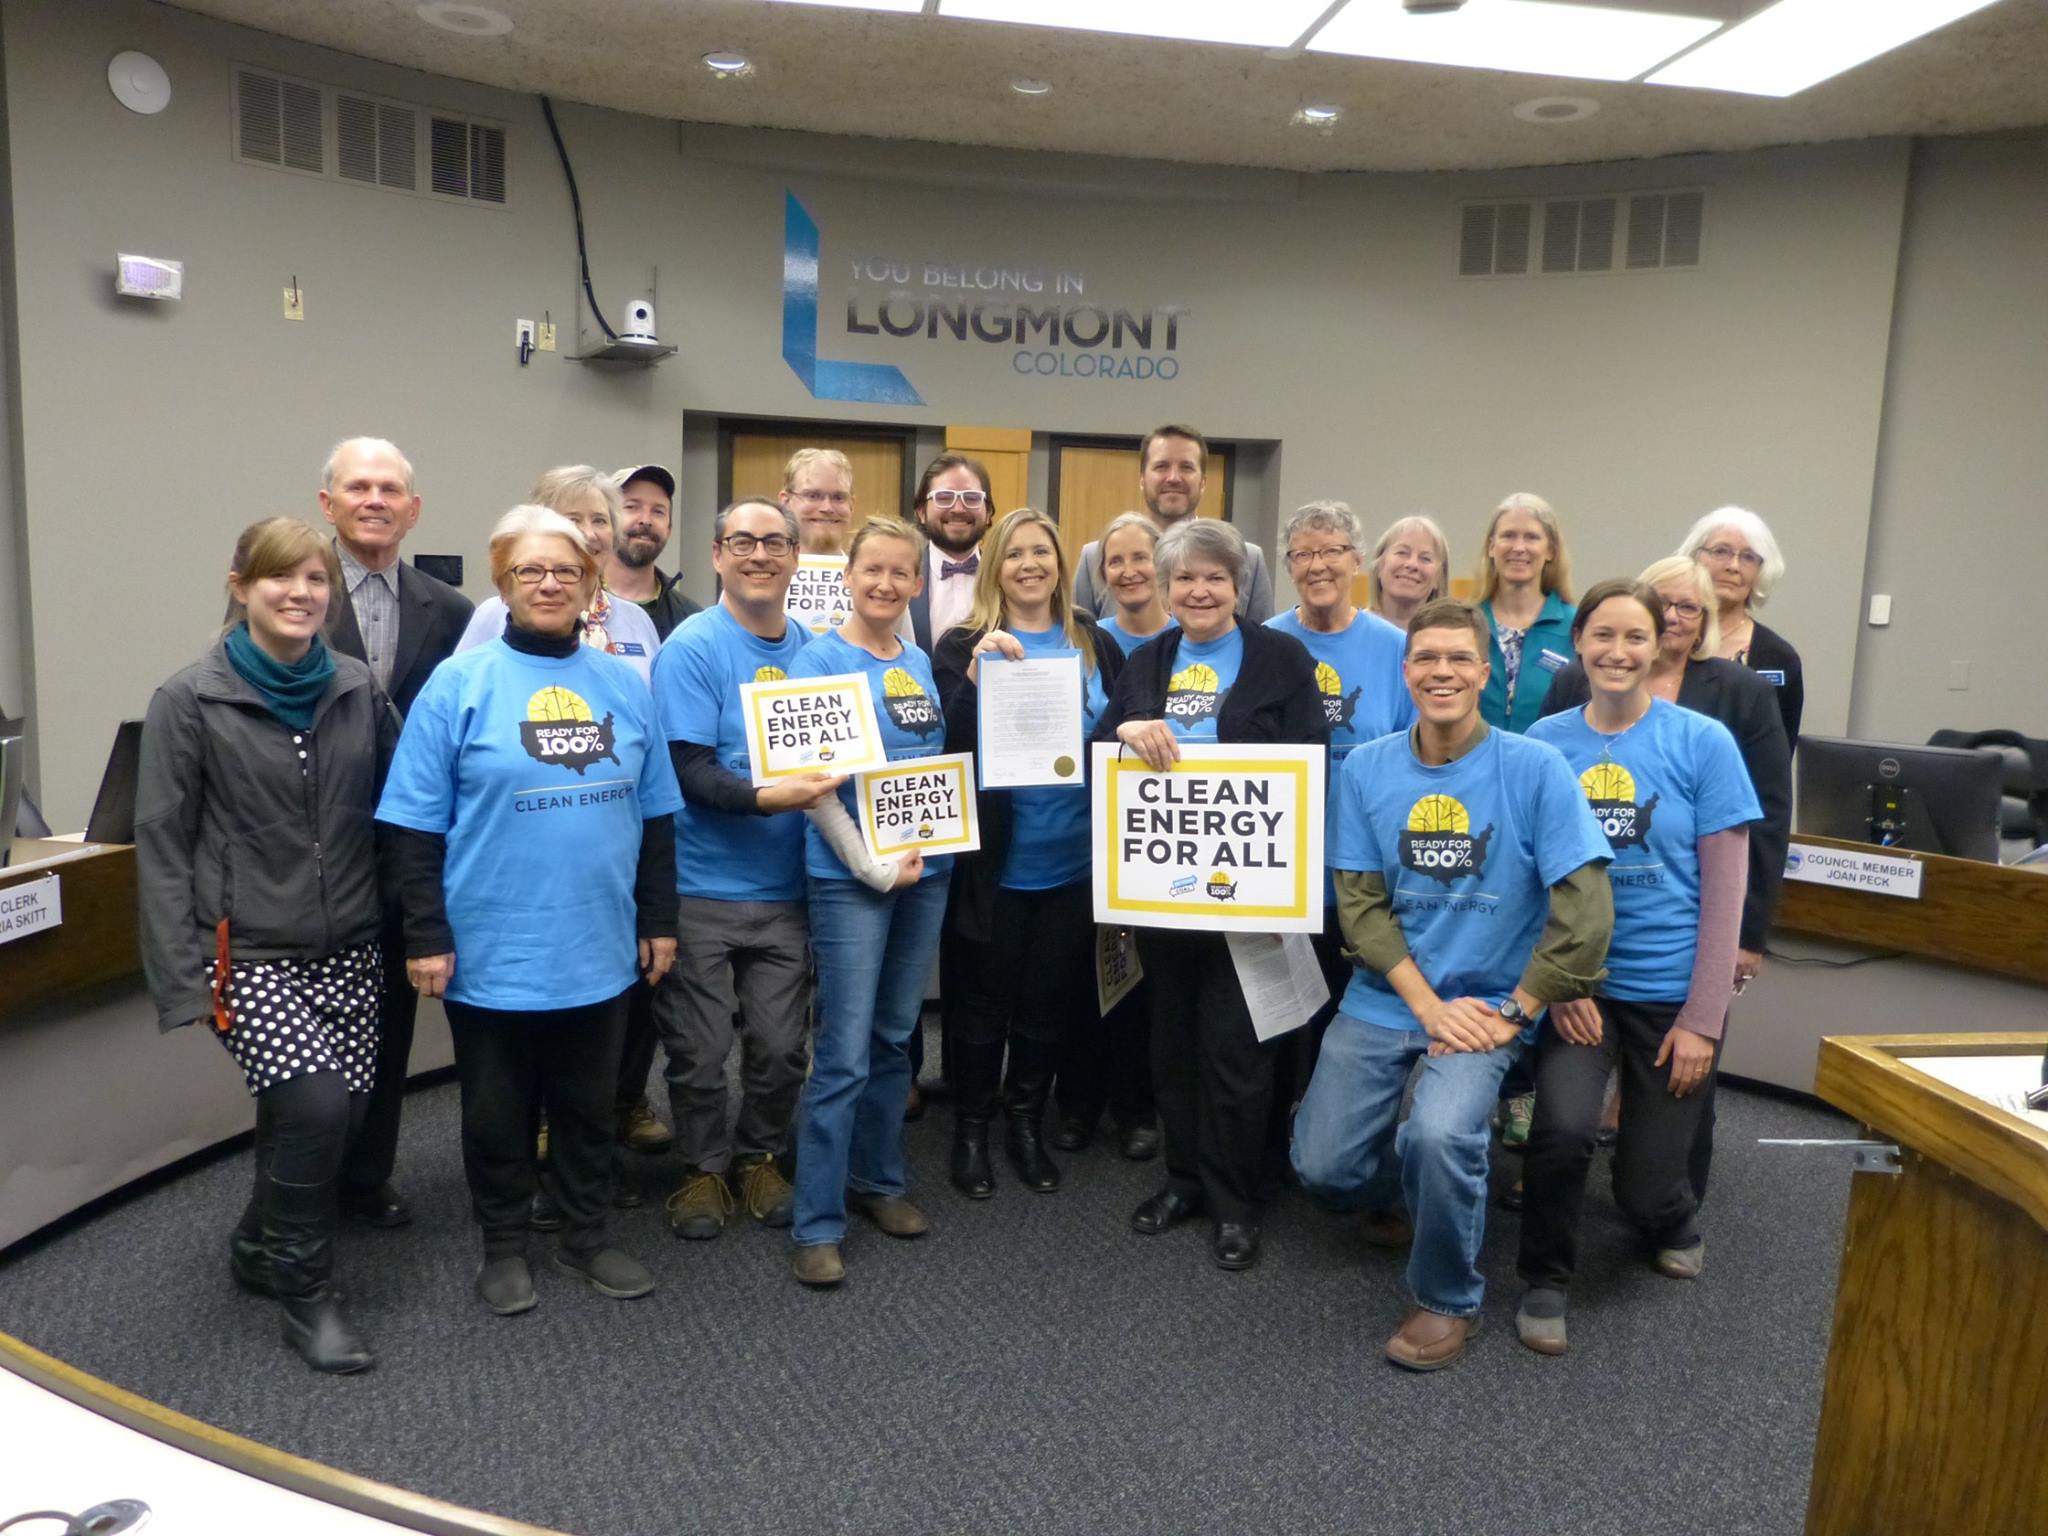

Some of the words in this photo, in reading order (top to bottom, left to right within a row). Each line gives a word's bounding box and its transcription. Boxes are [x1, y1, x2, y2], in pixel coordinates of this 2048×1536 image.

[851, 257, 911, 284] YOU
[922, 263, 1043, 292] BELONG
[1056, 272, 1084, 295] IN
[847, 292, 1190, 351] LONGMONT
[1012, 351, 1180, 381] COLORADO
[796, 570, 844, 583] CLEA
[789, 584, 852, 597] ENERG
[787, 598, 826, 611] FOR
[833, 599, 854, 611] AL
[772, 694, 842, 714] CLEAN
[1165, 700, 1215, 716] 100%
[767, 709, 851, 732] ENERGY
[897, 707, 938, 724] 100%
[536, 727, 573, 738] READY
[575, 726, 599, 735] FOR
[768, 732, 812, 750] FOR
[820, 726, 859, 744] ALL
[538, 735, 604, 756] 100%
[881, 773, 946, 794] CLEAN
[1138, 777, 1269, 805] CLEAN
[514, 795, 573, 813] CLEAN
[876, 789, 954, 812] ENERGY
[876, 810, 913, 829] FOR
[920, 805, 958, 822] ALL
[1126, 808, 1284, 837] ENERGY
[1591, 808, 1611, 817] ADY
[1613, 808, 1636, 817] FOR
[1601, 817, 1636, 837] 0%
[1124, 838, 1198, 866] FOR
[1211, 841, 1287, 868] ALL
[1411, 840, 1446, 849] READY
[1448, 840, 1471, 849] FOR
[1412, 849, 1473, 868] 100%
[1807, 854, 1860, 870] COUNCIL
[1862, 862, 1914, 878] MEMBER
[1613, 872, 1665, 887] NERGY
[1827, 869, 1857, 882] JOAN
[1859, 874, 1890, 887] PECK
[0, 893, 39, 914] CLERK
[15, 907, 47, 928] SKITT
